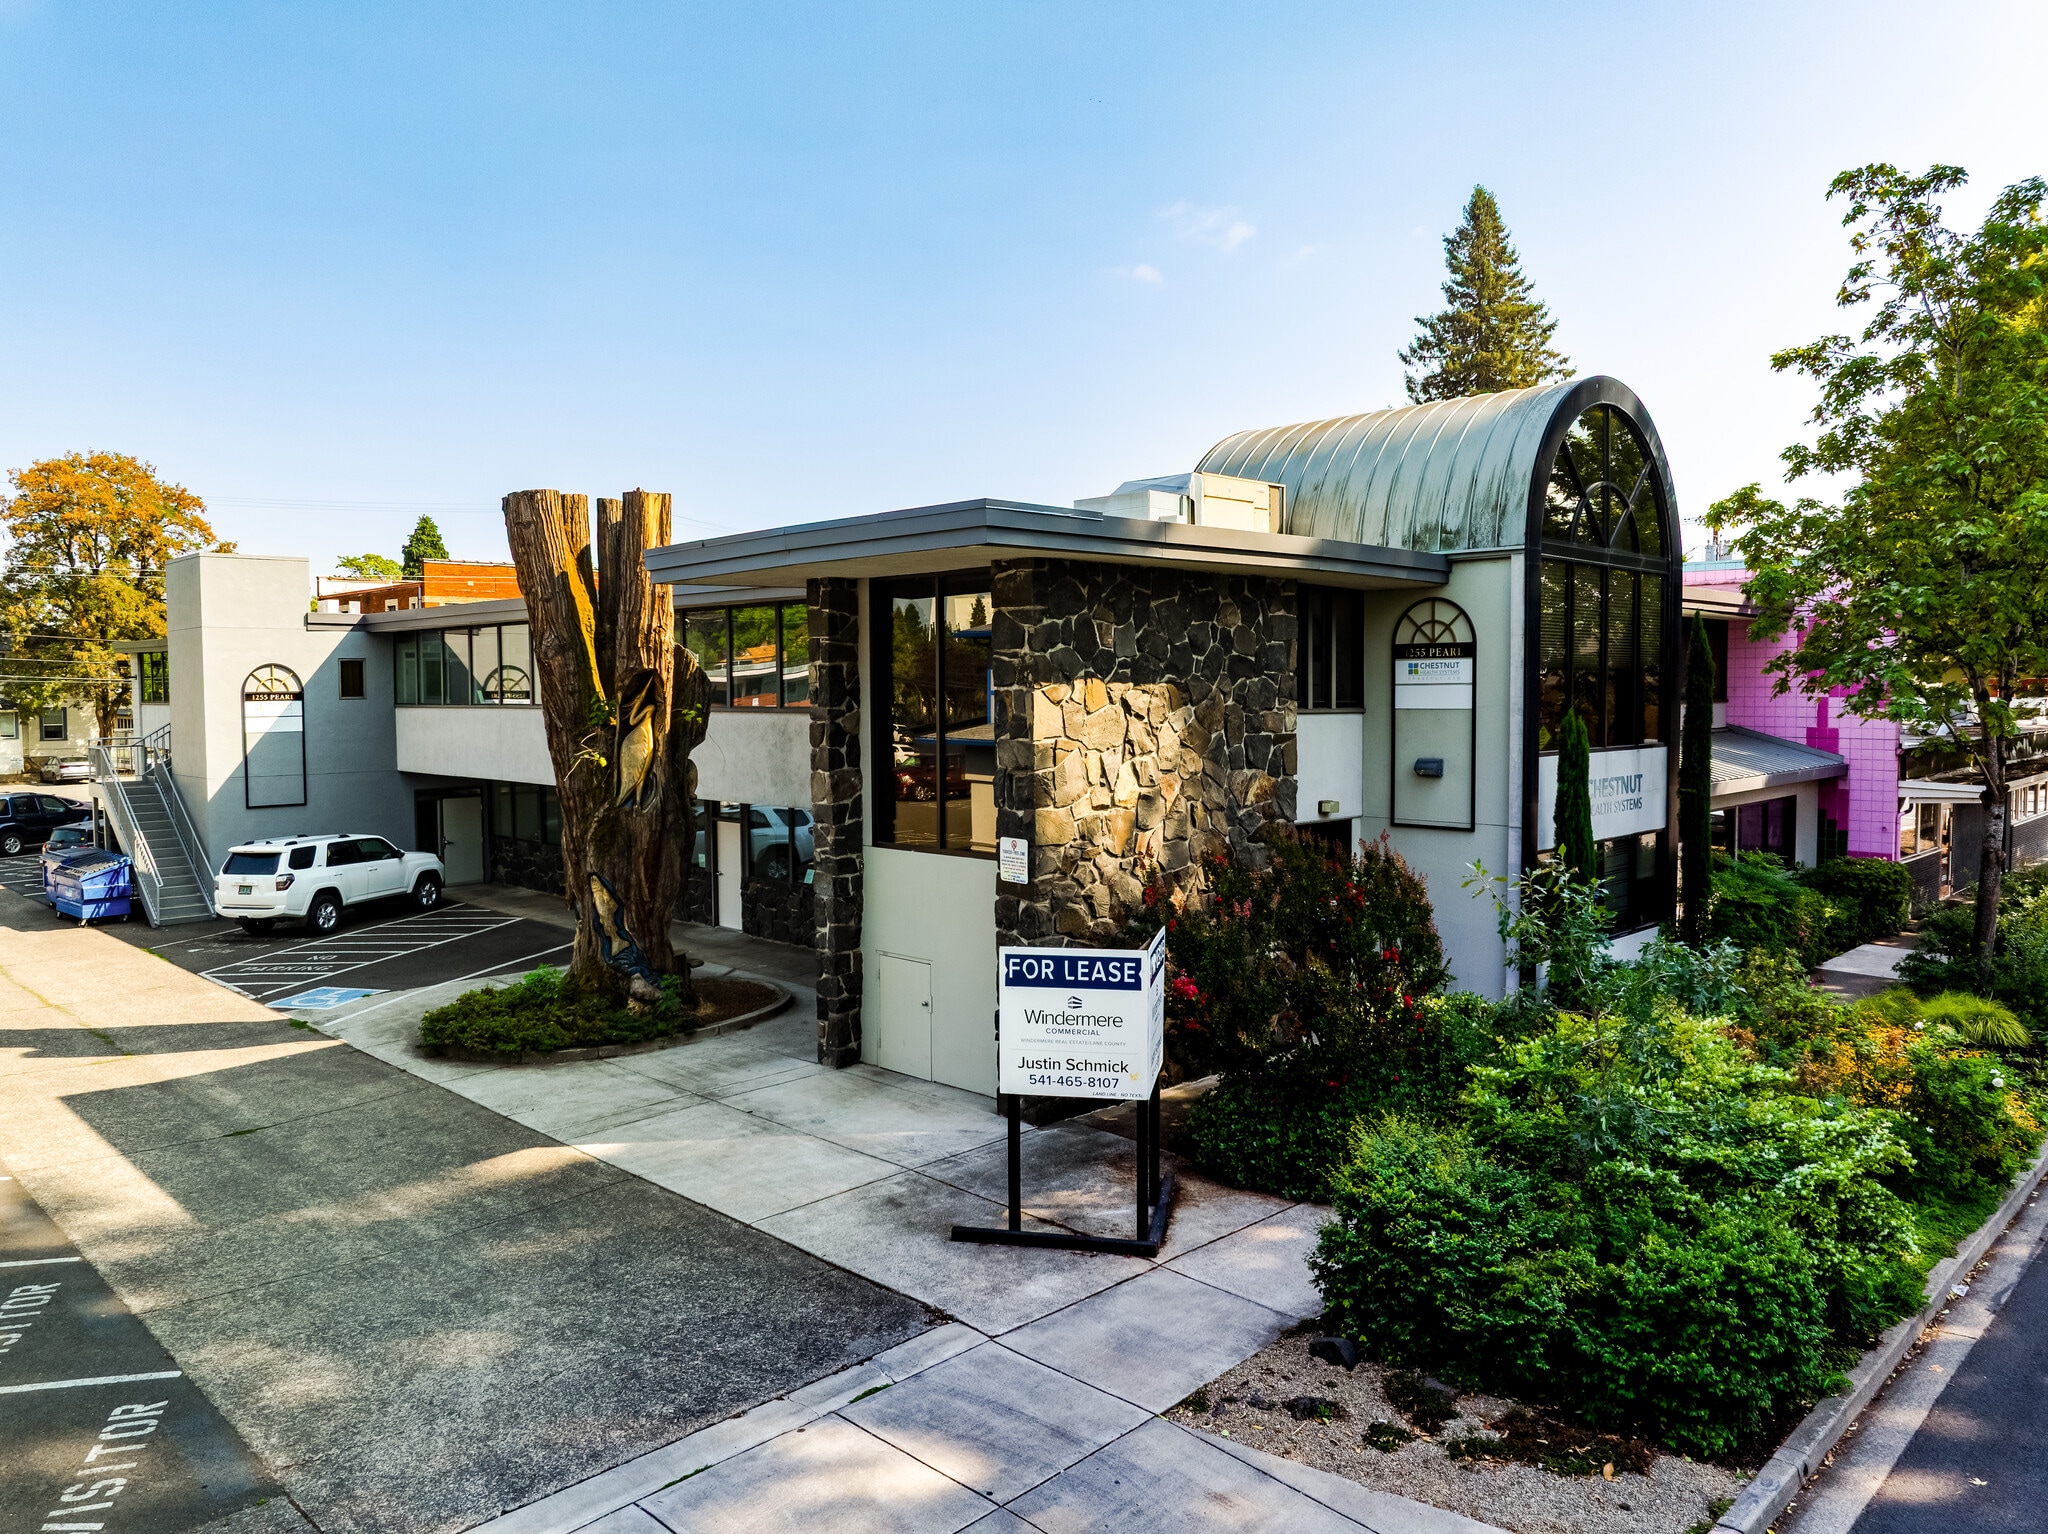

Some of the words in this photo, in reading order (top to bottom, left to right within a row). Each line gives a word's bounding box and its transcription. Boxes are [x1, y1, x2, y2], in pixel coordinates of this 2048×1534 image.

[1405, 647, 1426, 657] 1255
[1429, 647, 1464, 657] PEARL
[1420, 662, 1460, 670] CHESTNUT
[1591, 801, 1612, 816] EALTH
[1613, 797, 1643, 813] SYSTEMS
[1008, 958, 1055, 980] FOR
[1064, 959, 1136, 983] LEASE
[1024, 1009, 1124, 1028] Windermere
[1045, 1027, 1101, 1036] COMMERCIAL
[1017, 1056, 1061, 1070] Justin
[1065, 1058, 1129, 1073] Schmick
[1029, 1074, 1120, 1089] 541-465-8107
